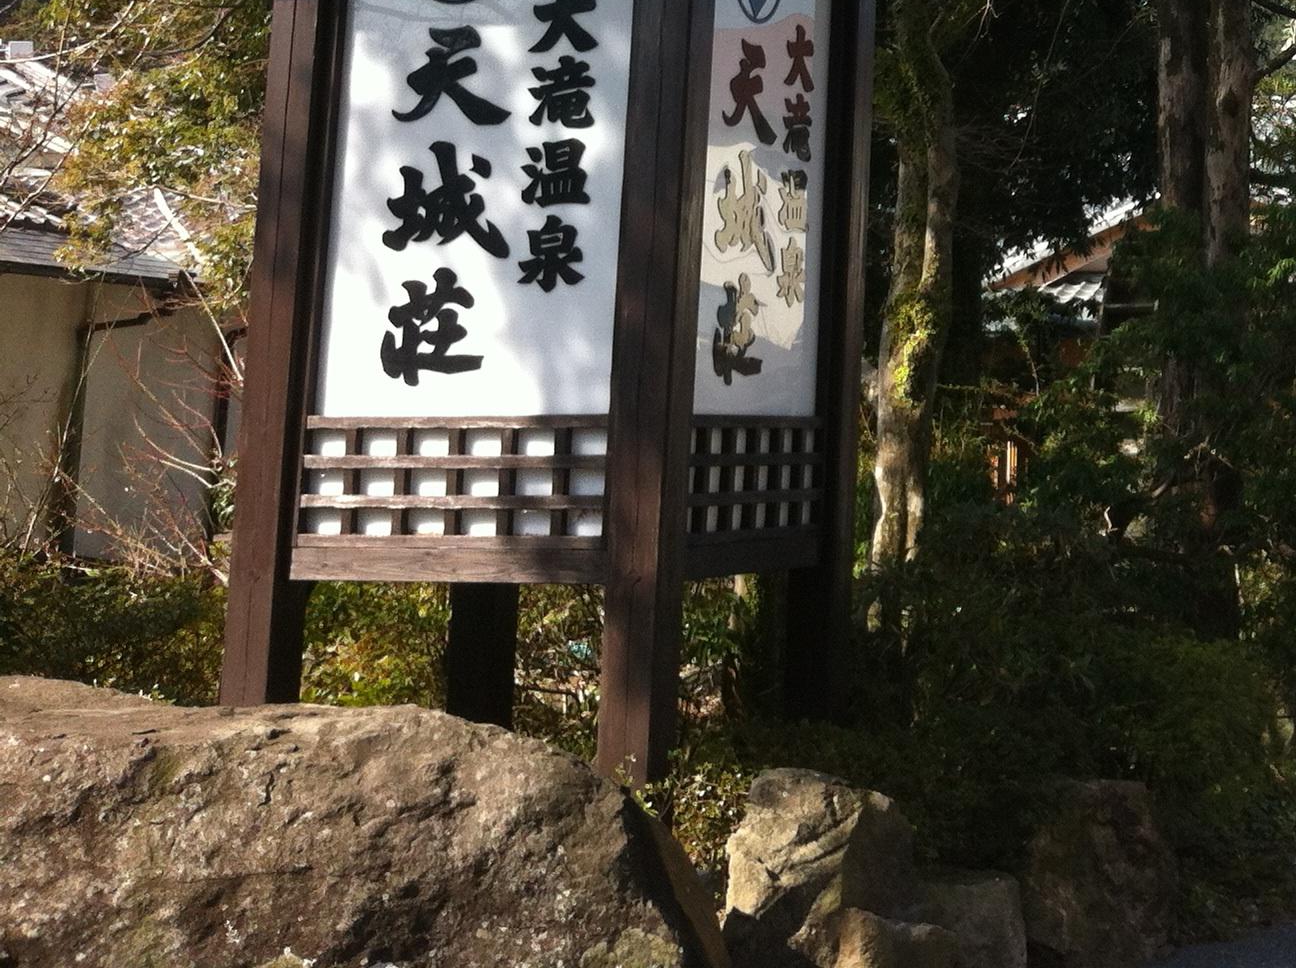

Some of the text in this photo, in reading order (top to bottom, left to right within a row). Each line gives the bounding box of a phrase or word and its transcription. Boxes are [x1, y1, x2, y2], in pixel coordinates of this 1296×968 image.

[381, 25, 511, 386] 天城荘
[712, 38, 777, 386] 天城荘
[777, 24, 815, 308] 大滝温泉
